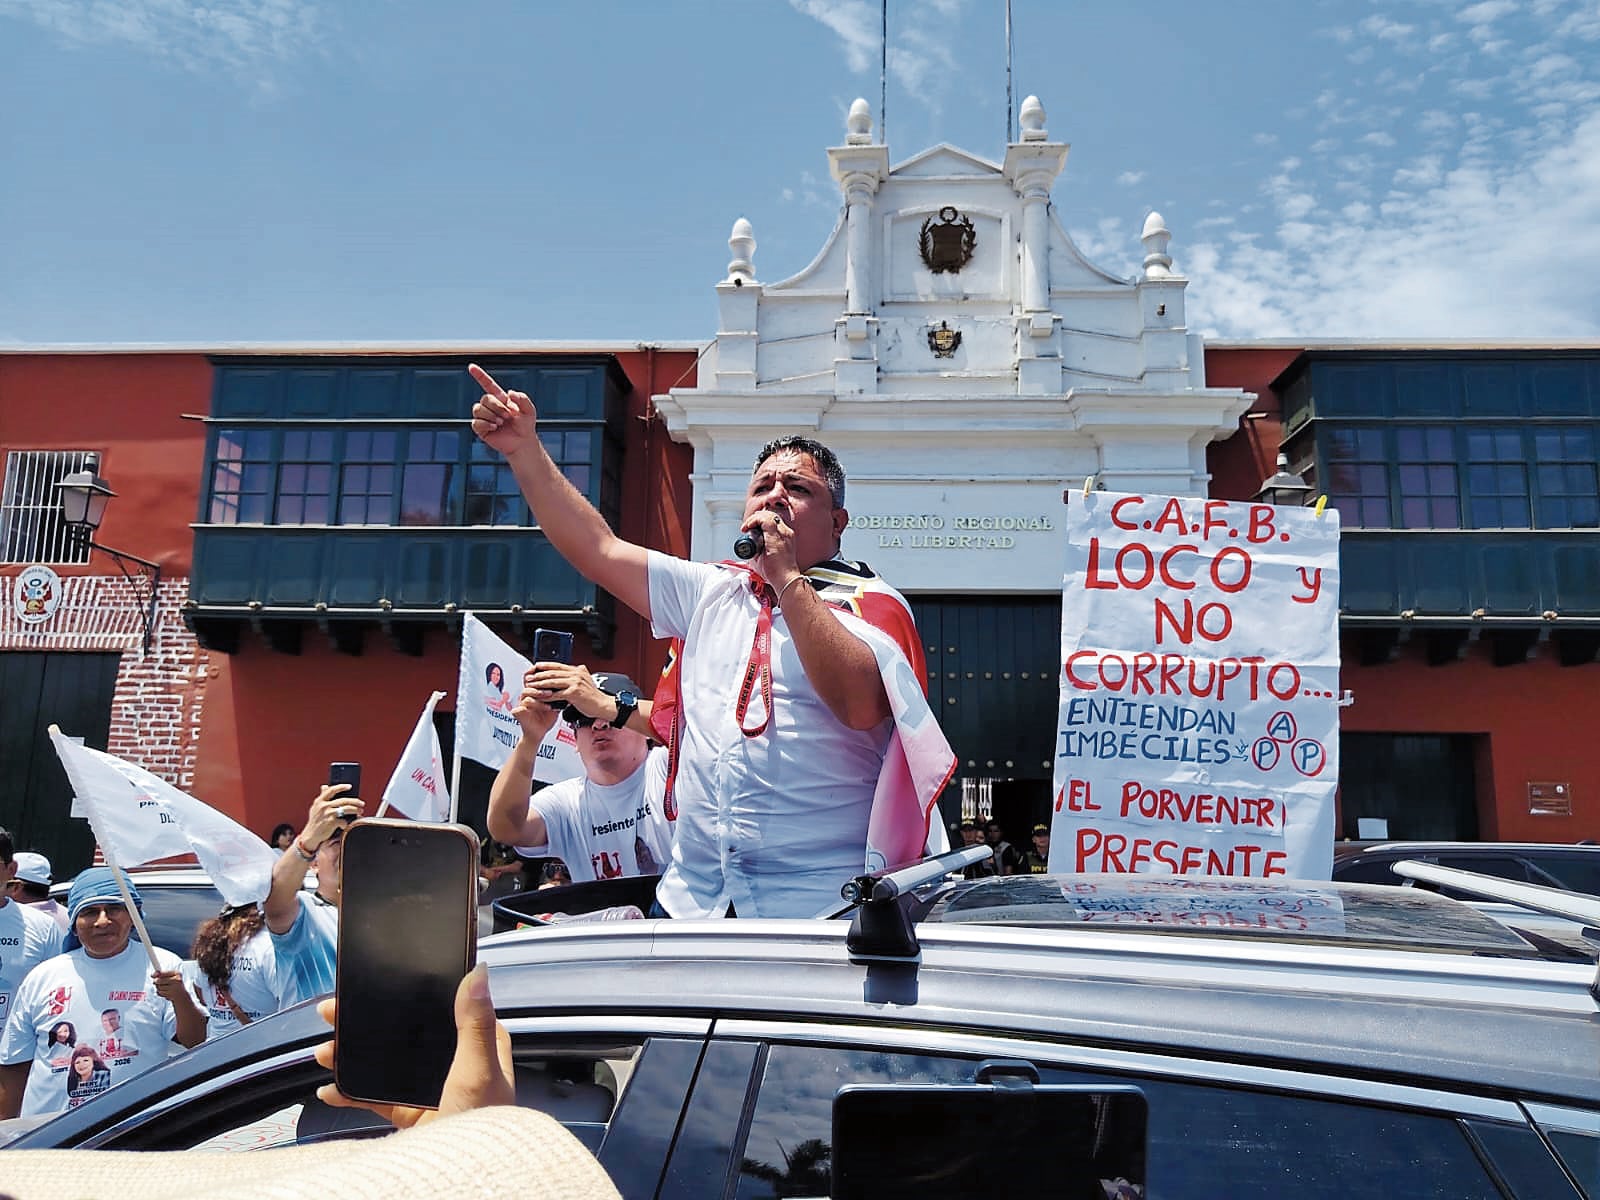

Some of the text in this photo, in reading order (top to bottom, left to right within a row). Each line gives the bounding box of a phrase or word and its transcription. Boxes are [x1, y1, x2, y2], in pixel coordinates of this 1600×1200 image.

[954, 515, 1054, 530] REGIONAL
[1111, 496, 1290, 543] C.A.F.B.
[879, 535, 1015, 549] LA LIBERTAD
[1085, 537, 1252, 593] LOCO
[1154, 598, 1233, 645] NO
[1065, 650, 1332, 701] CORRUPTO...
[1066, 697, 1236, 735] ENTIENDAN
[1058, 730, 1232, 764] IMBÉCILES
[1075, 828, 1287, 879] PRESENTE
[0, 937, 19, 946] 026
